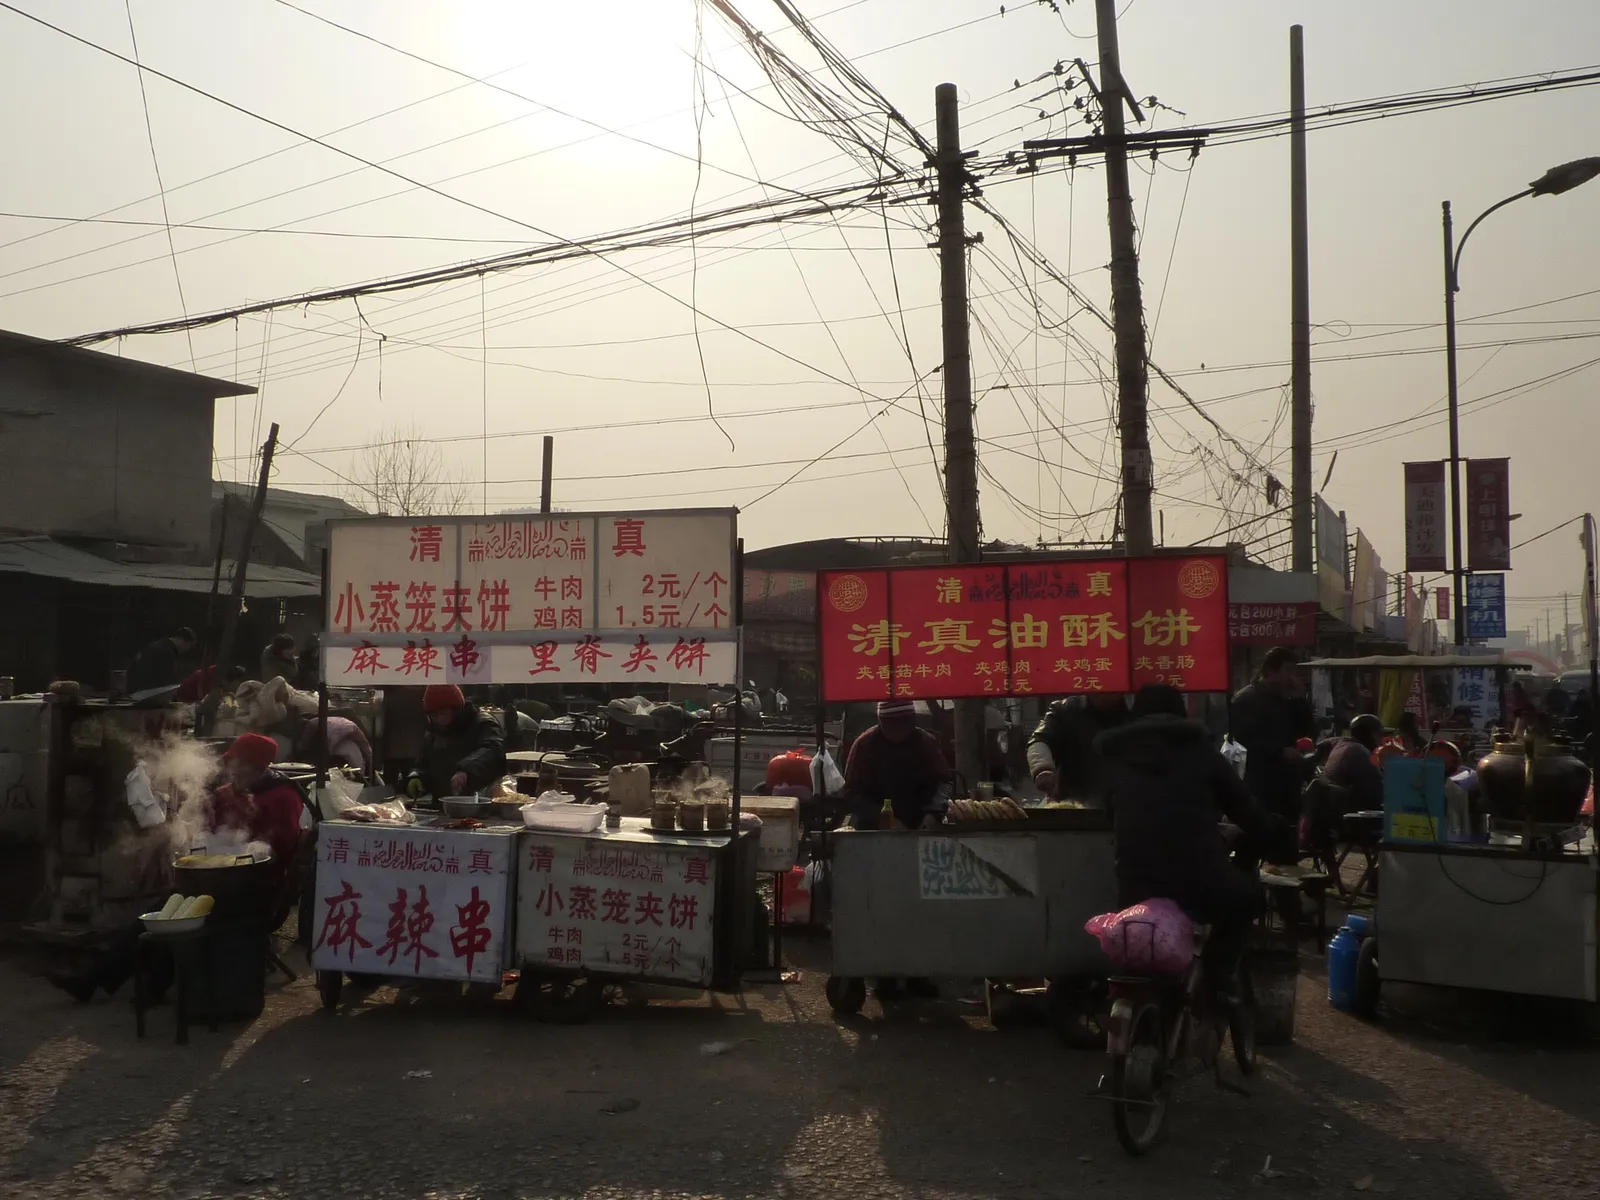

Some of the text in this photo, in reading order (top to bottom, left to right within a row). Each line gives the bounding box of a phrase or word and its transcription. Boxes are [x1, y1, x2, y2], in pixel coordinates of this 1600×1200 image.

[409, 525, 443, 563] 清
[613, 520, 646, 557] 真
[534, 576, 583, 601] 牛肉
[642, 572, 728, 600] 2元/个
[936, 576, 962, 604] 清
[1087, 571, 1112, 596] 真
[1468, 576, 1502, 621] 精修手机
[334, 579, 510, 633] 小蒸笼夹饼
[533, 606, 583, 629] 鸡肉
[616, 604, 728, 628] 1.5元/个
[848, 608, 1202, 656] 清真油酥饼
[344, 635, 712, 678] 麻辣串 里脊夹饼
[856, 655, 1195, 680] 夹香菇牛肉 夹鸡肉 夹鸡蛋 夹香肠
[1073, 675, 1103, 690] 2元
[1155, 673, 1185, 688] 2元
[326, 838, 350, 864] 清
[469, 848, 493, 874] 真
[529, 846, 554, 873] 清
[684, 856, 710, 885] 真
[536, 884, 698, 931] 小蒸笼夹饼
[313, 881, 492, 975] 麻辣串
[548, 926, 682, 952] 牛肉 2元/个
[547, 946, 581, 964] 鸡肉
